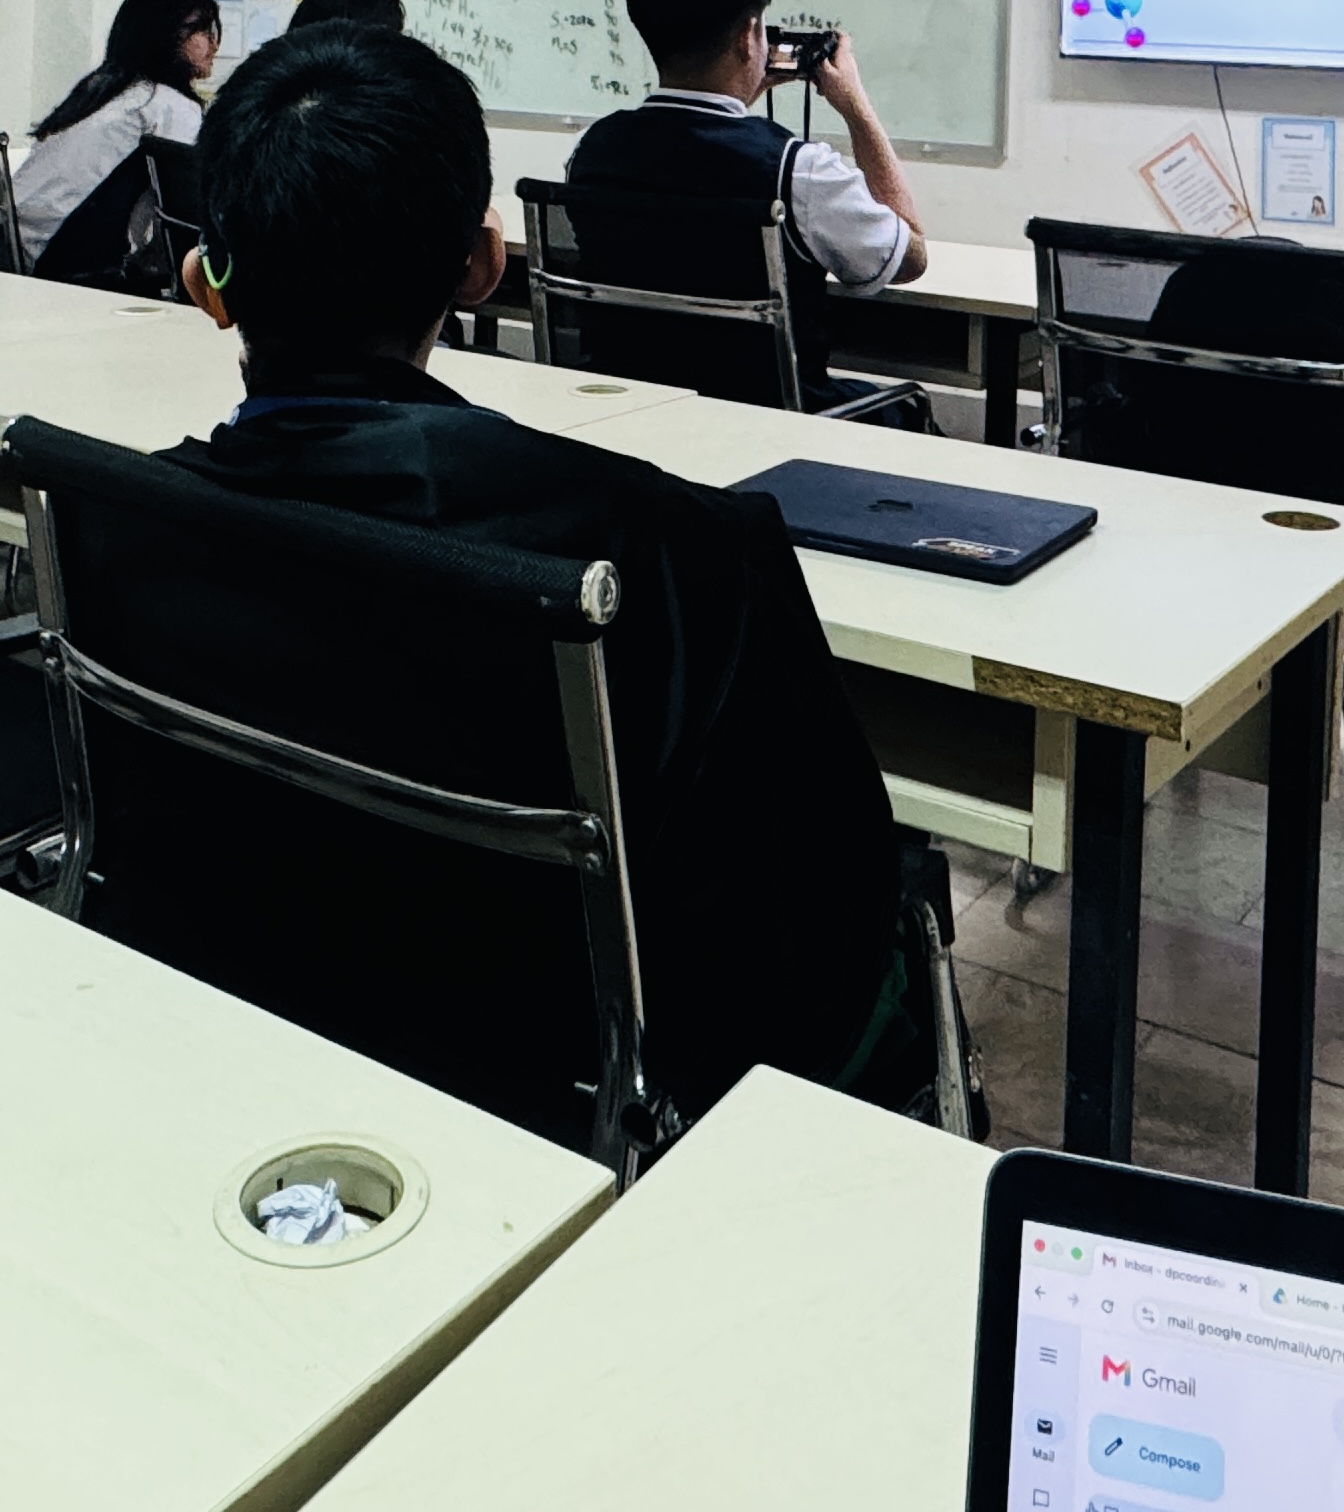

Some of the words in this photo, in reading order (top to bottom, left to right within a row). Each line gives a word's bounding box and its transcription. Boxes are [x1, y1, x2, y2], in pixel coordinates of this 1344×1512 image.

[1124, 1258, 1153, 1276] Inbox
[1296, 1294, 1330, 1311] Home
[1141, 1368, 1197, 1397] Gmail
[1031, 1449, 1055, 1464] Mail
[1139, 1446, 1202, 1474] Compose
